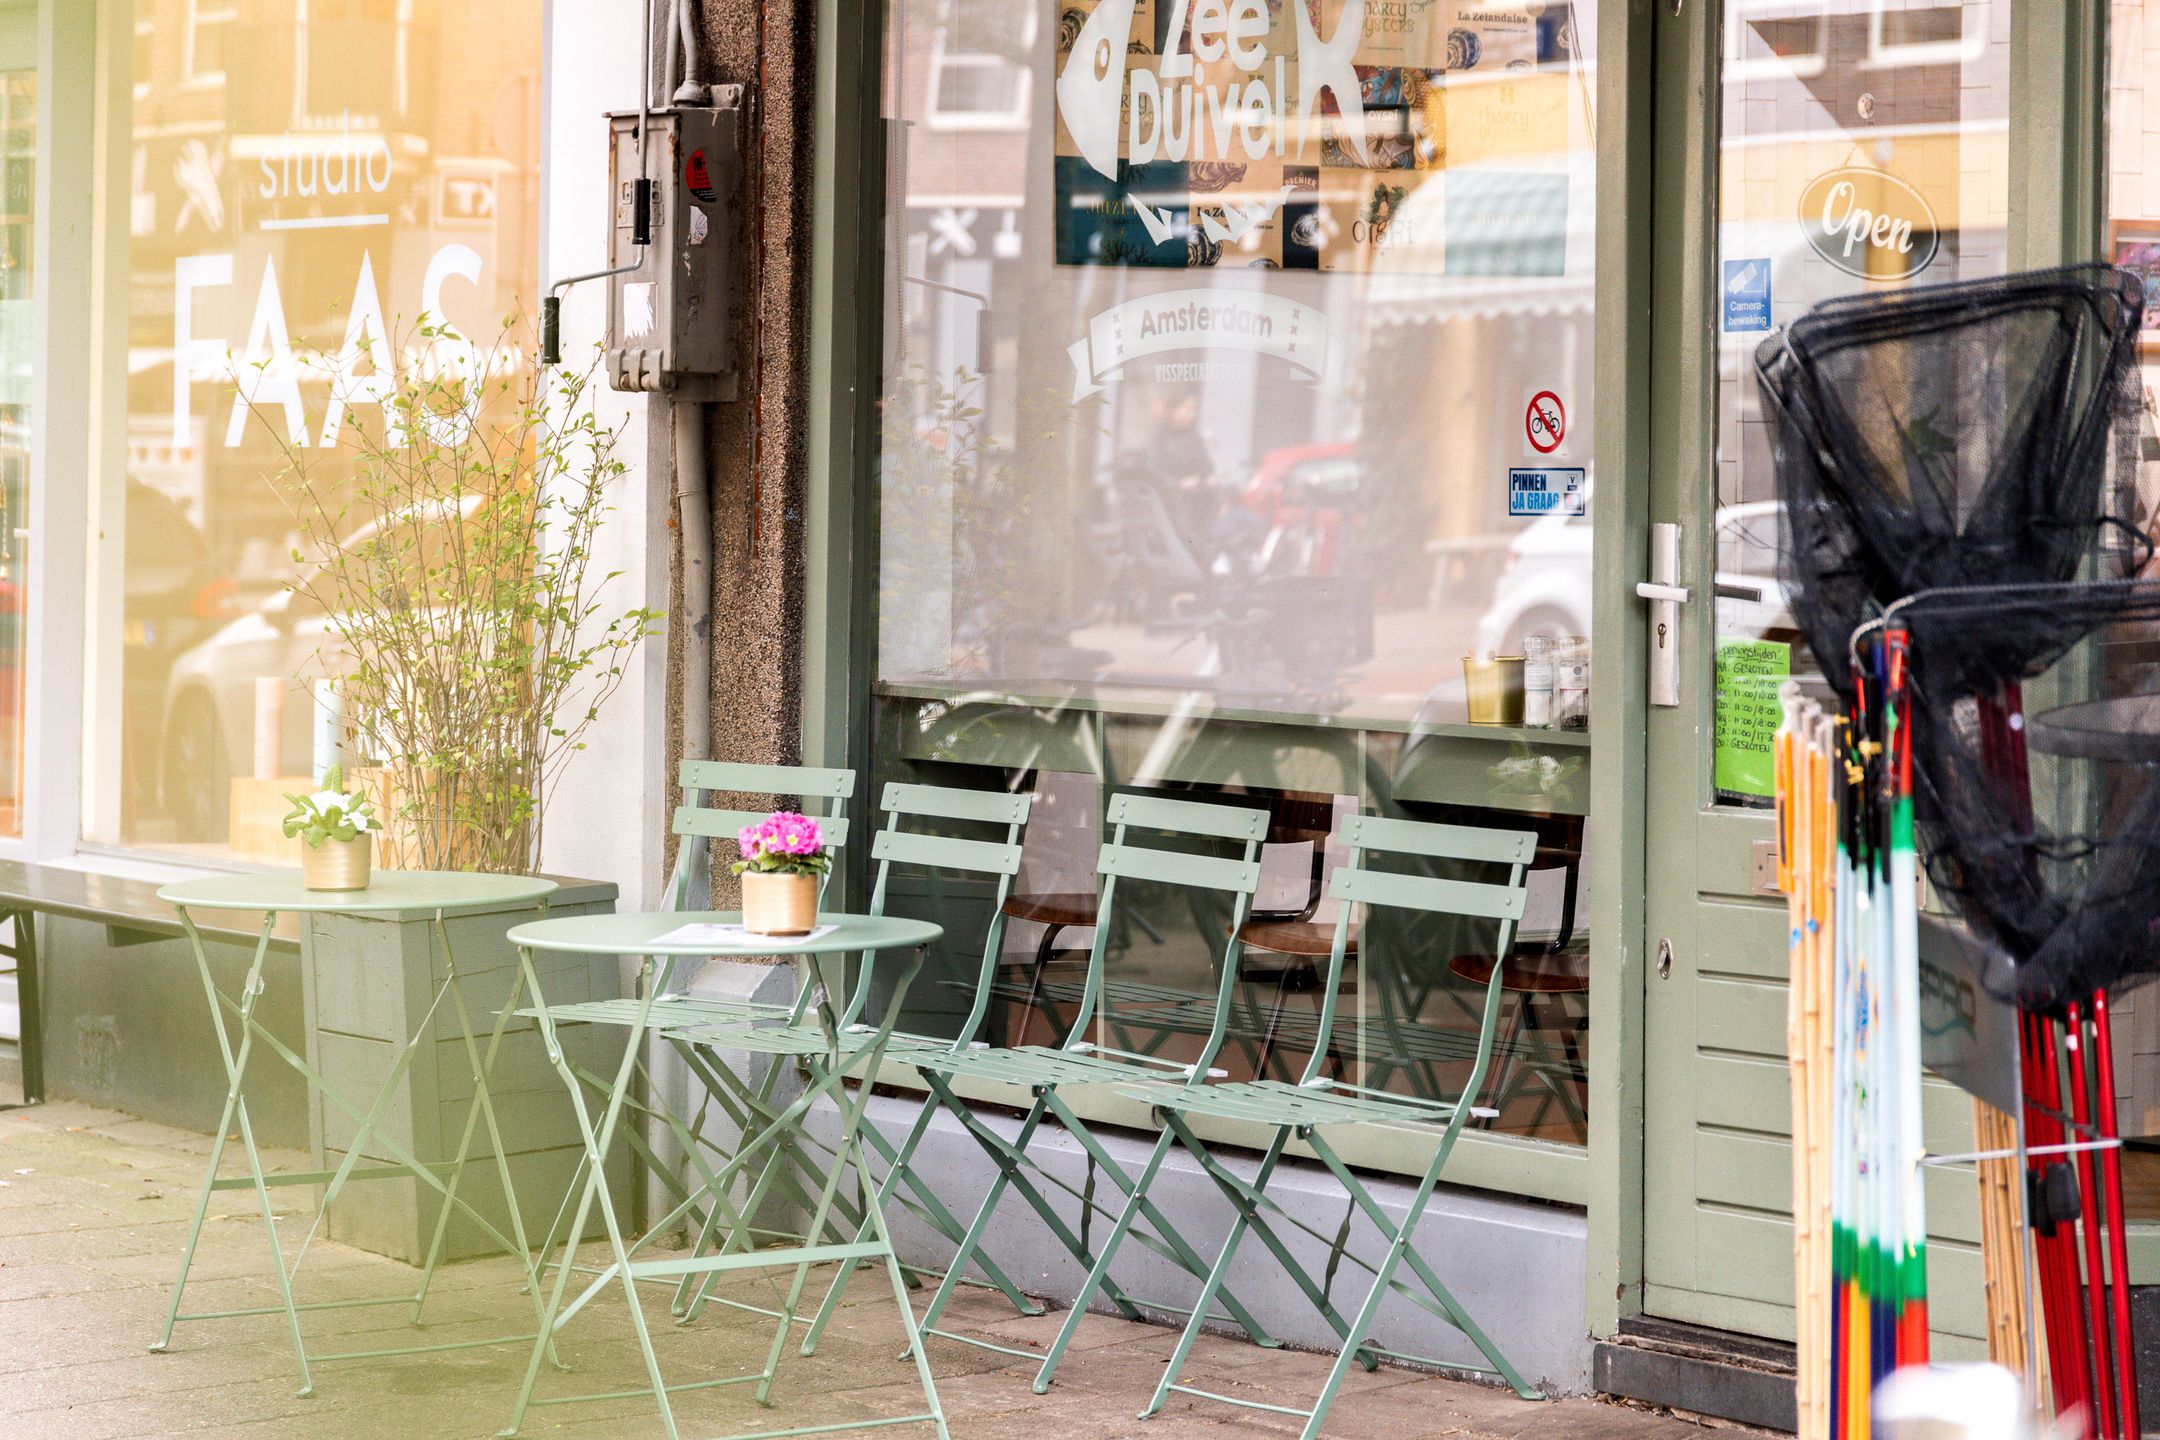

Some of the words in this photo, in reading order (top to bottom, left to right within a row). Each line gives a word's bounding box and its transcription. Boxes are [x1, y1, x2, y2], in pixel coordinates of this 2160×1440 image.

[258, 106, 392, 199] studio
[1822, 181, 1913, 257] Open
[1730, 301, 1765, 311] Camera-
[1140, 302, 1273, 339] Amsterdam
[1728, 315, 1767, 327] bewaking
[173, 244, 483, 449] FAAS
[1512, 474, 1547, 491] PINNEN
[1512, 492, 1525, 510] JA
[1527, 492, 1560, 510] GRAAG
[1733, 662, 1773, 675] GESLOTEN
[1731, 740, 1770, 753] GESLOTEN
